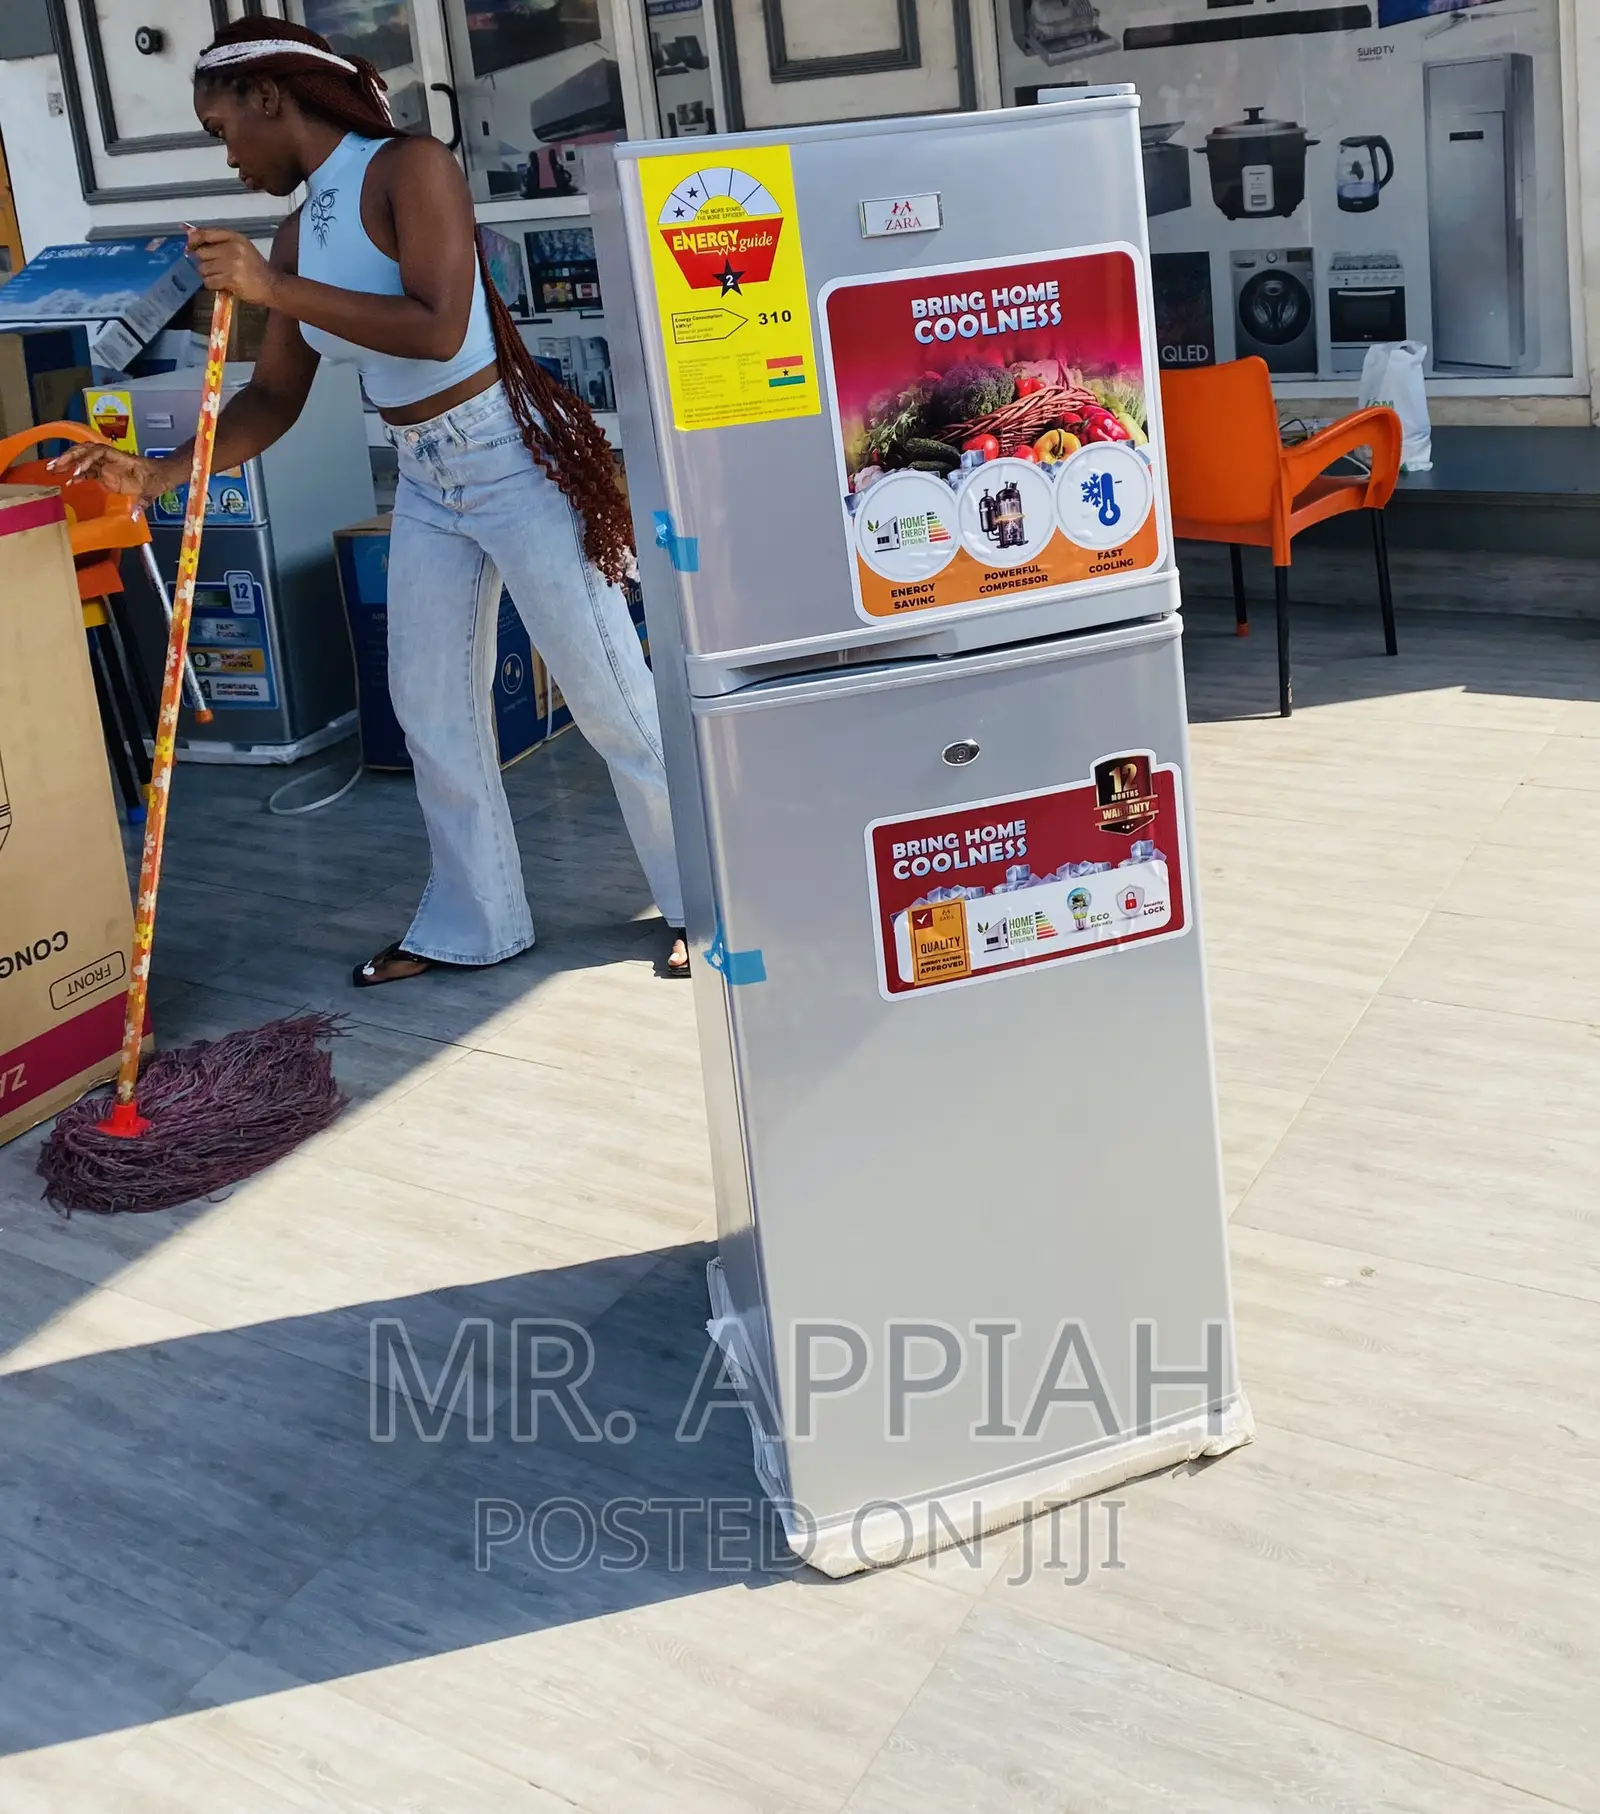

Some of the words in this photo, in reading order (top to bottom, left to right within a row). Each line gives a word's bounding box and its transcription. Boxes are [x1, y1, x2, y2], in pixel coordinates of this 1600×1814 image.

[1357, 47, 1382, 56] SUHD
[1382, 45, 1395, 54] TV
[885, 217, 921, 230] ZARA
[672, 230, 738, 254] ENERGY
[739, 231, 773, 252] guide
[726, 275, 734, 286] 2
[911, 290, 985, 319] BRING
[991, 280, 1060, 308] HOME
[758, 310, 792, 325] 310
[914, 302, 1062, 344] COOLNESS
[1161, 344, 1209, 362] QLED
[900, 514, 926, 530] HOME
[900, 527, 926, 539] ENERGY
[1097, 548, 1124, 561] FAST
[984, 565, 1042, 581] POWERFUL
[1088, 558, 1134, 573] COOLING
[233, 583, 250, 599] 12
[890, 583, 937, 598] ENERGY
[978, 574, 1048, 593] COMPRESSOR
[893, 596, 936, 610] SAVING
[1109, 763, 1138, 793] 12
[1111, 789, 1139, 801] MONTHS
[1102, 801, 1150, 820] WARRANTY
[892, 832, 959, 860] BRING
[965, 819, 1027, 845] HOME
[893, 837, 1028, 880] COOLNESS
[1143, 900, 1164, 908] Security
[1143, 905, 1165, 915] LOCK
[1009, 914, 1034, 930] HOME
[1090, 912, 1110, 923] ECO
[1010, 926, 1034, 938] ENERGY
[920, 936, 960, 954] QUALITY
[920, 960, 964, 974] APPROVED
[921, 959, 941, 967] ENERGY
[66, 963, 112, 998] FRONT
